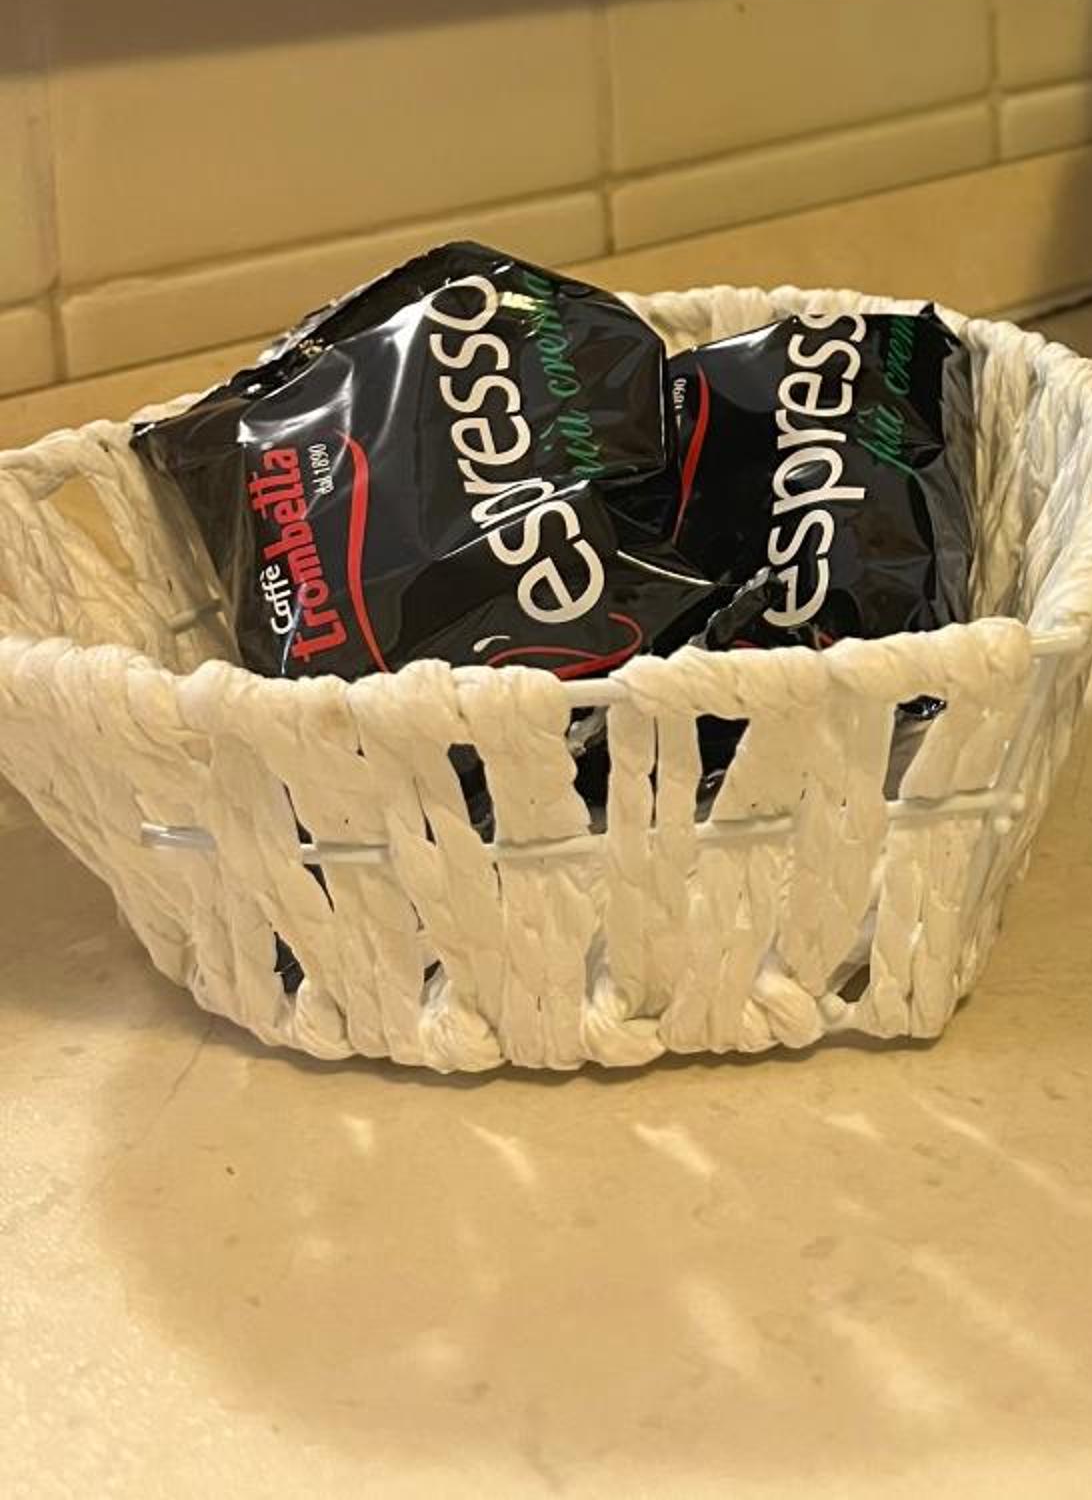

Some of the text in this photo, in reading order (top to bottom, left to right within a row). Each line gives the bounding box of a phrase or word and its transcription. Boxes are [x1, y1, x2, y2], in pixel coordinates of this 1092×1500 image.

[307, 444, 331, 476] 1890
[425, 275, 605, 623] espresso
[247, 448, 347, 663] trombetta
[260, 562, 293, 635] Caffè
